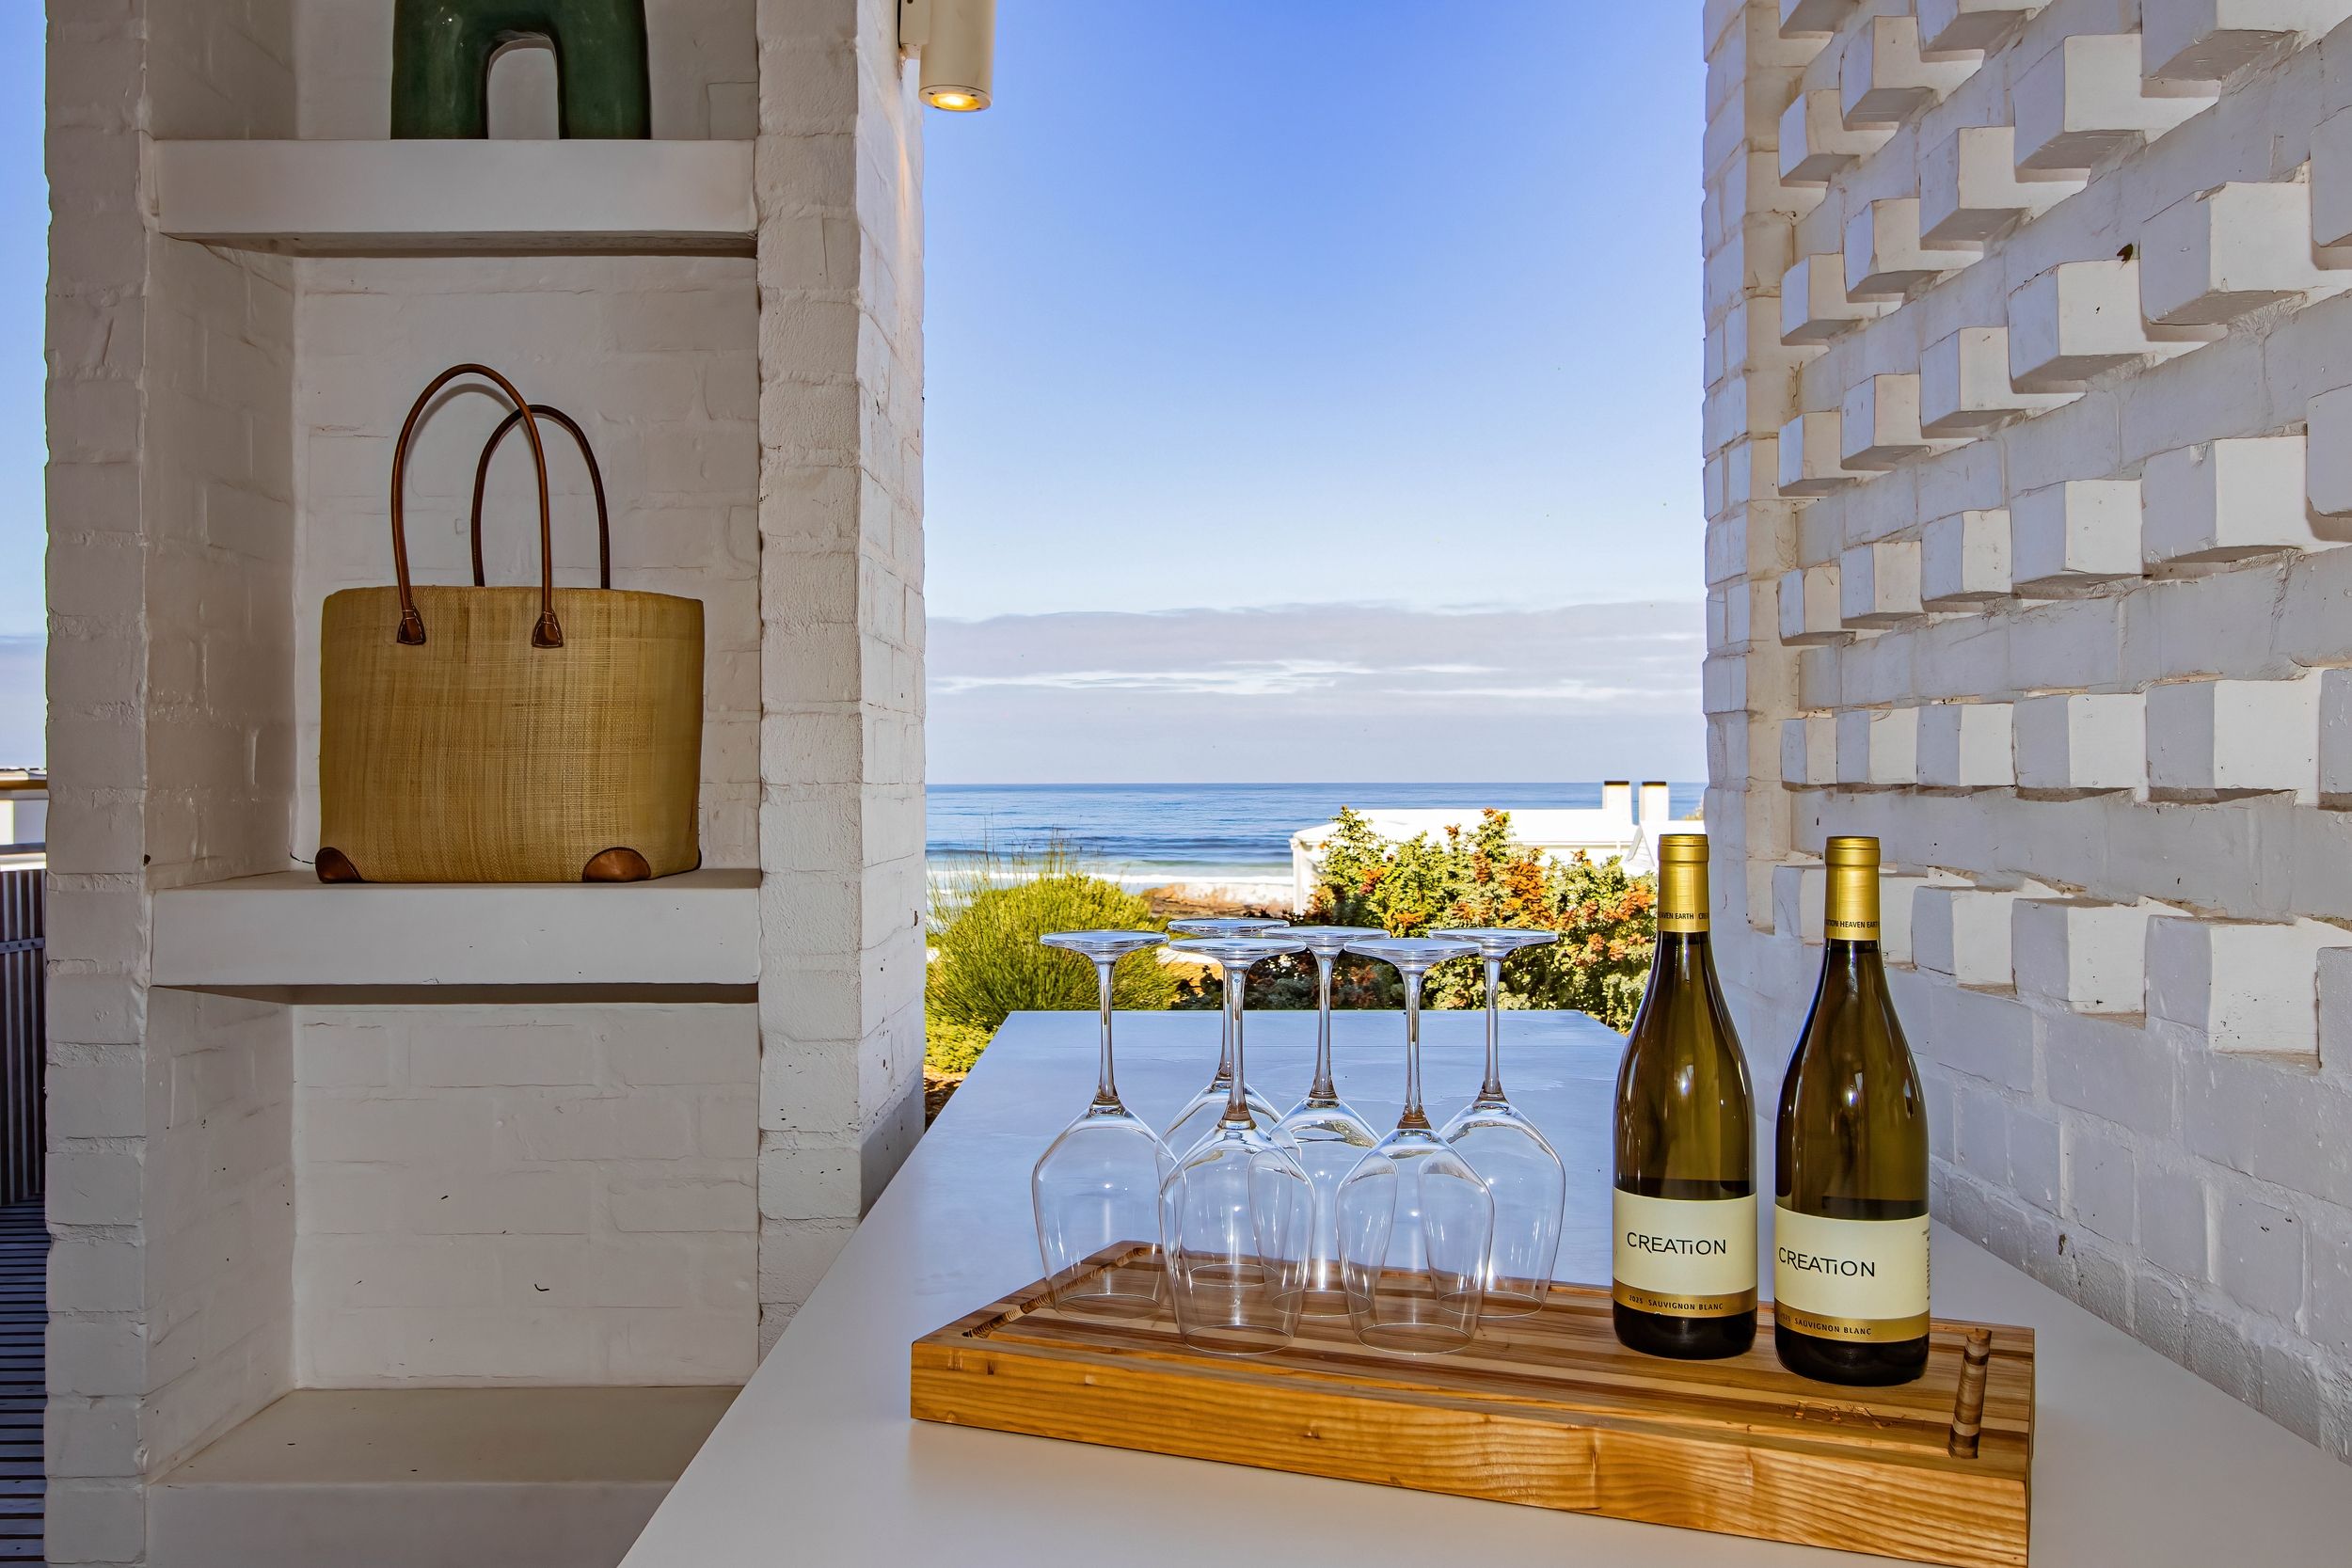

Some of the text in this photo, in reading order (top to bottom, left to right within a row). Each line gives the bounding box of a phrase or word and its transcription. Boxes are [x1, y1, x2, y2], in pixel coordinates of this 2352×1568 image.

[1627, 1231, 1726, 1256] CREATION
[1778, 1246, 1875, 1277] CREATION
[1648, 1299, 1695, 1310] SAUVIGNON
[1794, 1317, 1840, 1333] SAUVIGNON
[1843, 1326, 1872, 1336] BLANC
